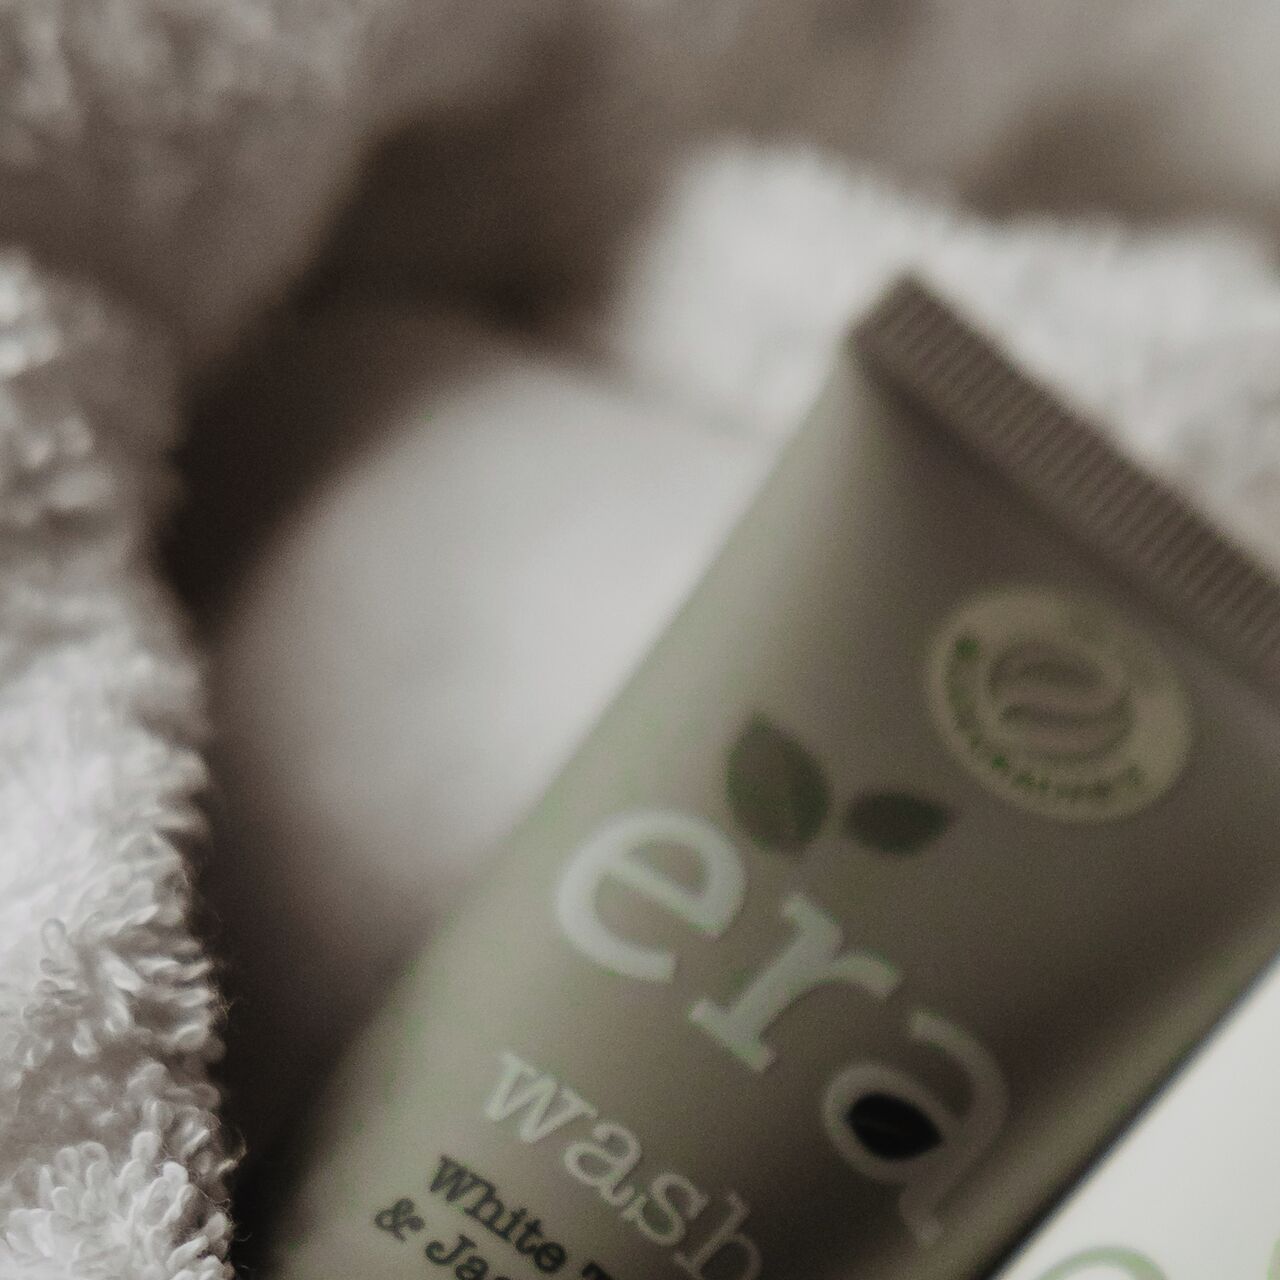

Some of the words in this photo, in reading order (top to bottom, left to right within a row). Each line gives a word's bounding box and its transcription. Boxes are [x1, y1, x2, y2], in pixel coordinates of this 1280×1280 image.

[553, 806, 1010, 1248] era
[373, 1197, 425, 1242] &
[428, 1155, 568, 1274] White
